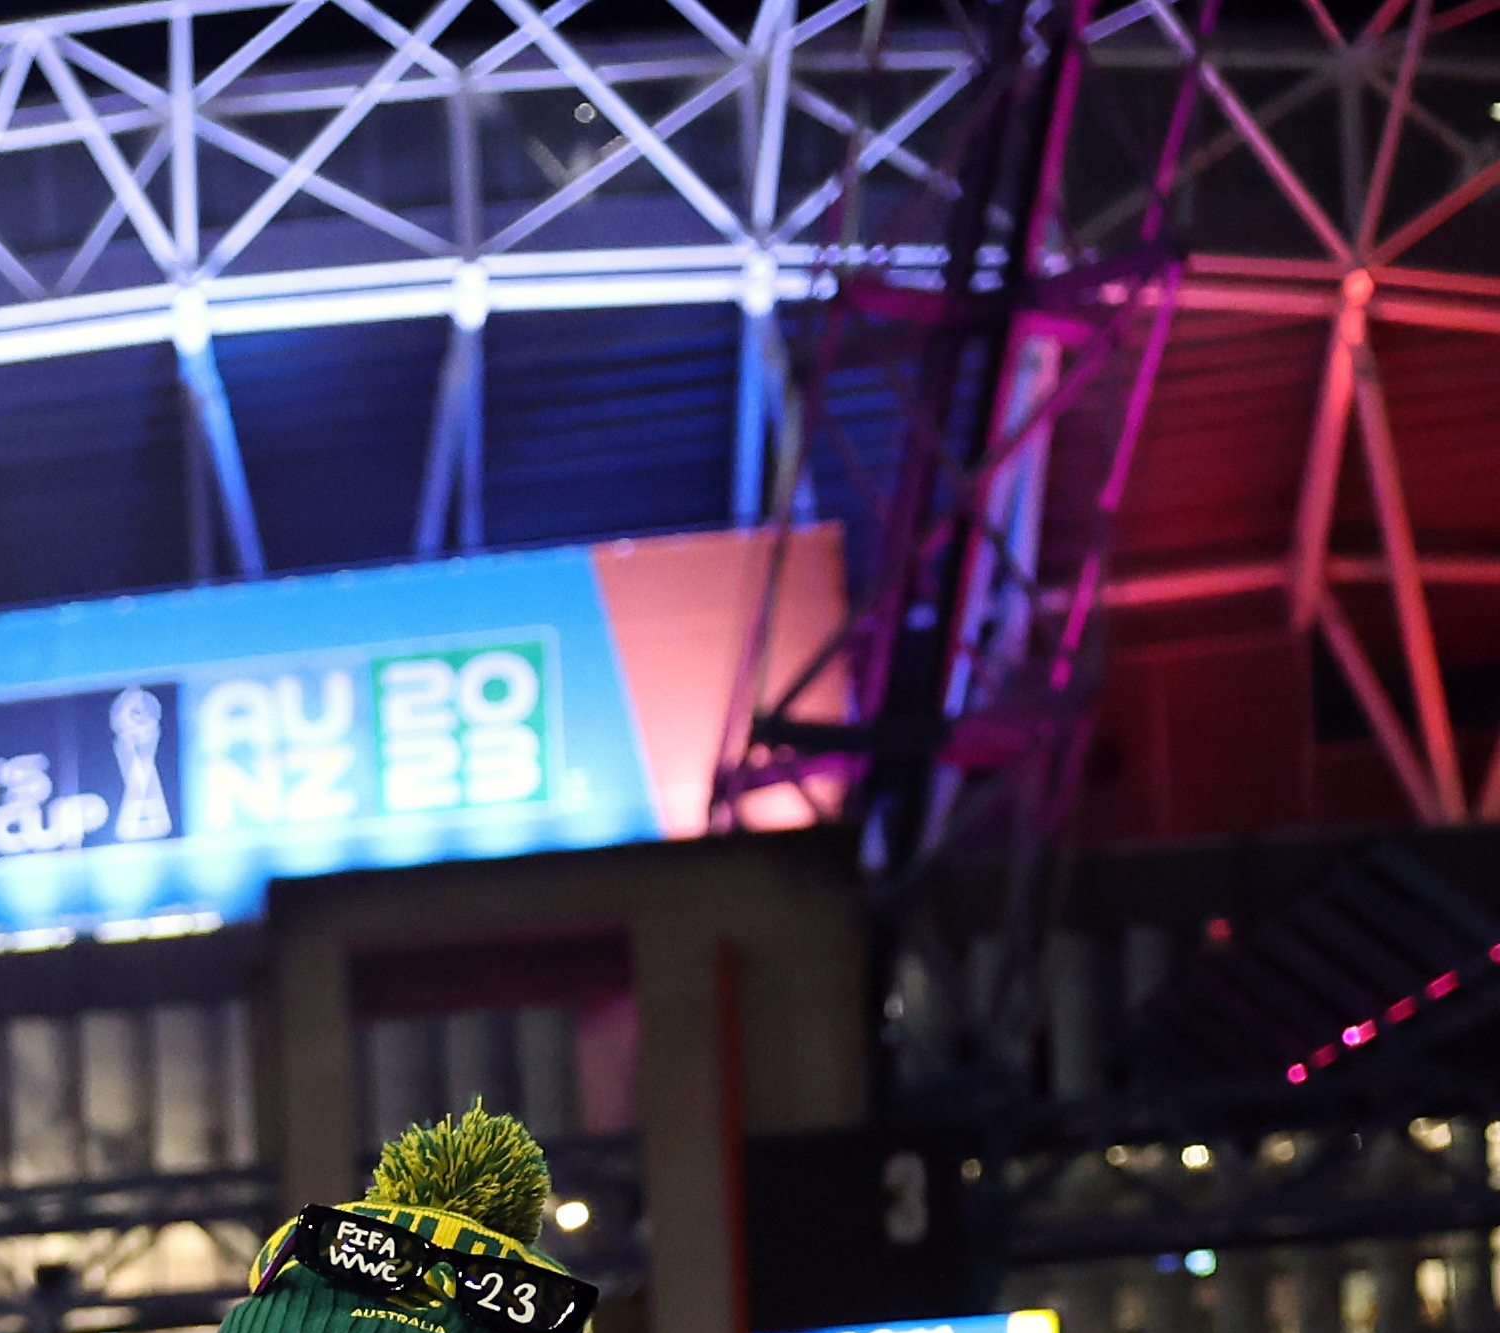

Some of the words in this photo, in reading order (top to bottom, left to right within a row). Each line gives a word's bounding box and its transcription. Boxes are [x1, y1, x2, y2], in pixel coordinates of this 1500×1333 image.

[200, 669, 356, 748] AU
[380, 650, 539, 736] 20
[204, 745, 358, 830] NZ
[383, 723, 542, 810] 23
[329, 1245, 398, 1283] WWC
[337, 1220, 396, 1258] FIFA
[476, 1272, 537, 1324] 23
